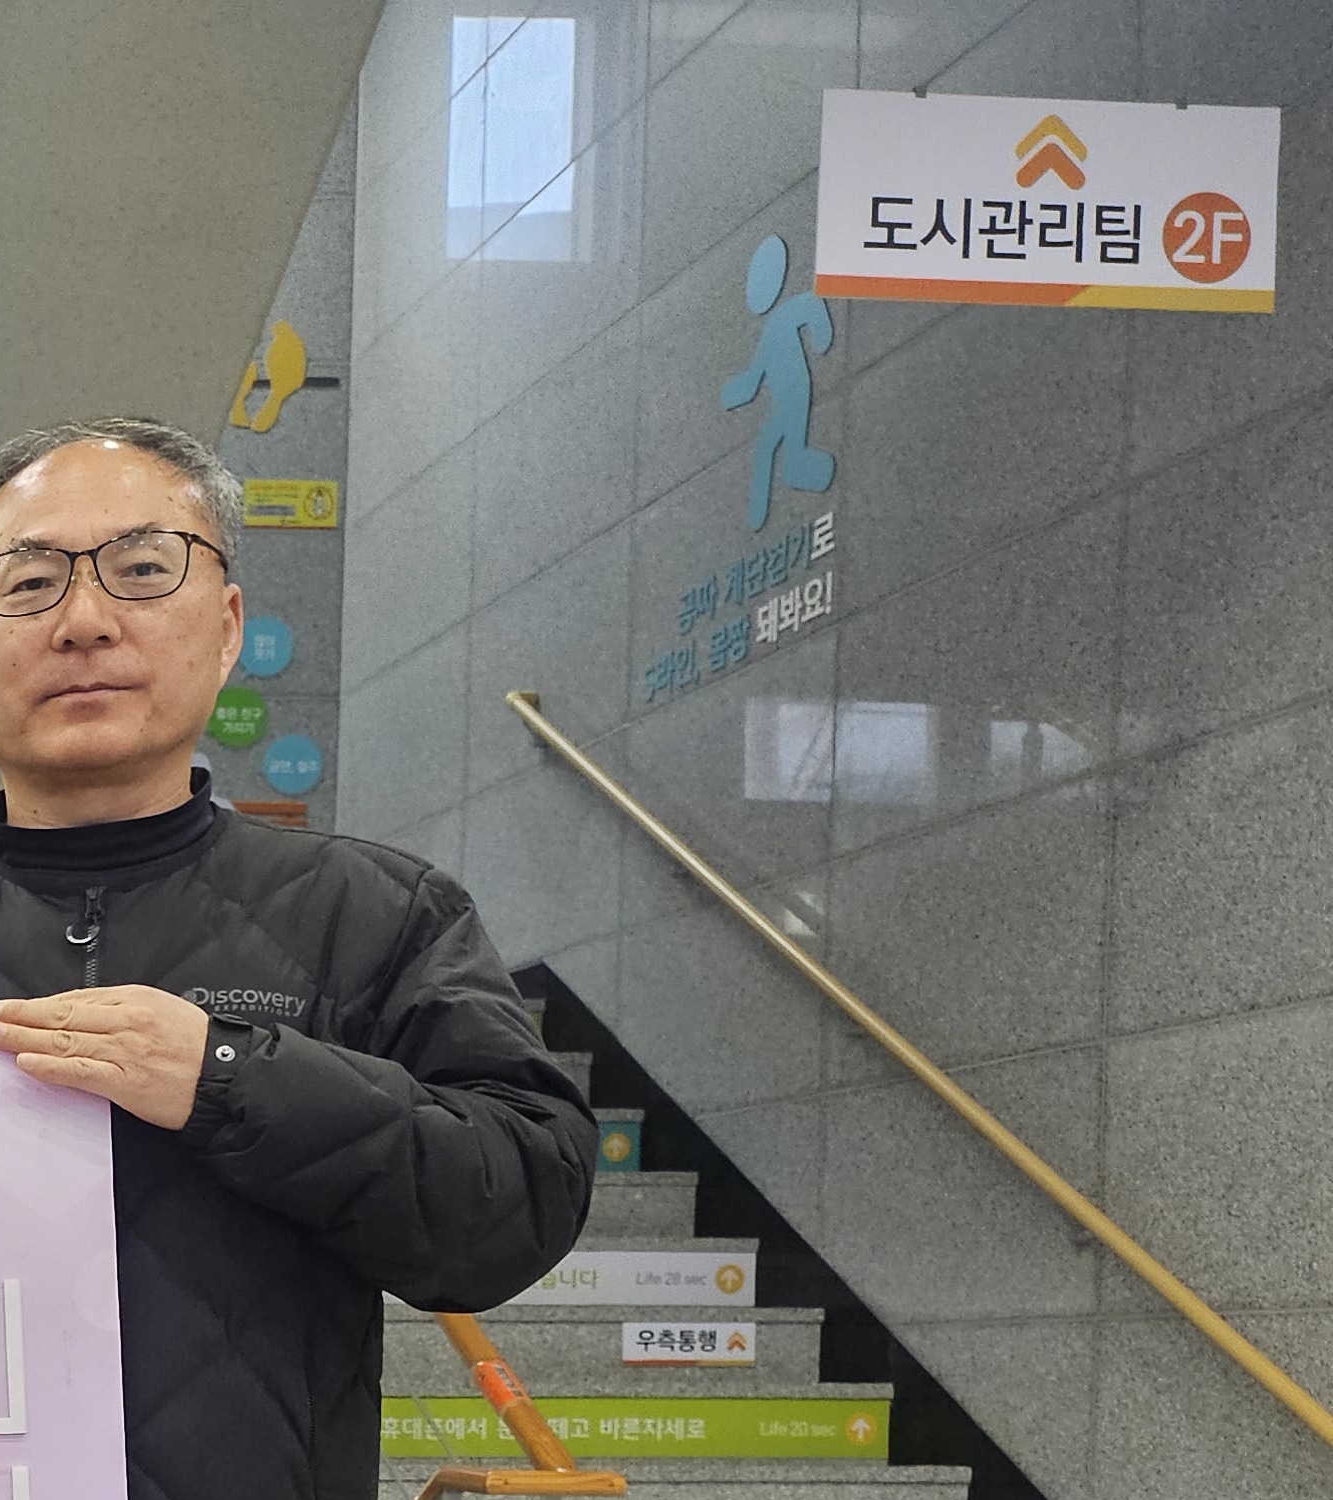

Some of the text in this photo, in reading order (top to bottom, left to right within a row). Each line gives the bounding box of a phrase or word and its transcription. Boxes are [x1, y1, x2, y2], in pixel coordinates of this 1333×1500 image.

[863, 196, 1244, 264] 도시관리팀 2F
[756, 570, 834, 643] 돼봐요!
[533, 1269, 599, 1290] 습니다
[635, 1329, 717, 1353] 우측통행
